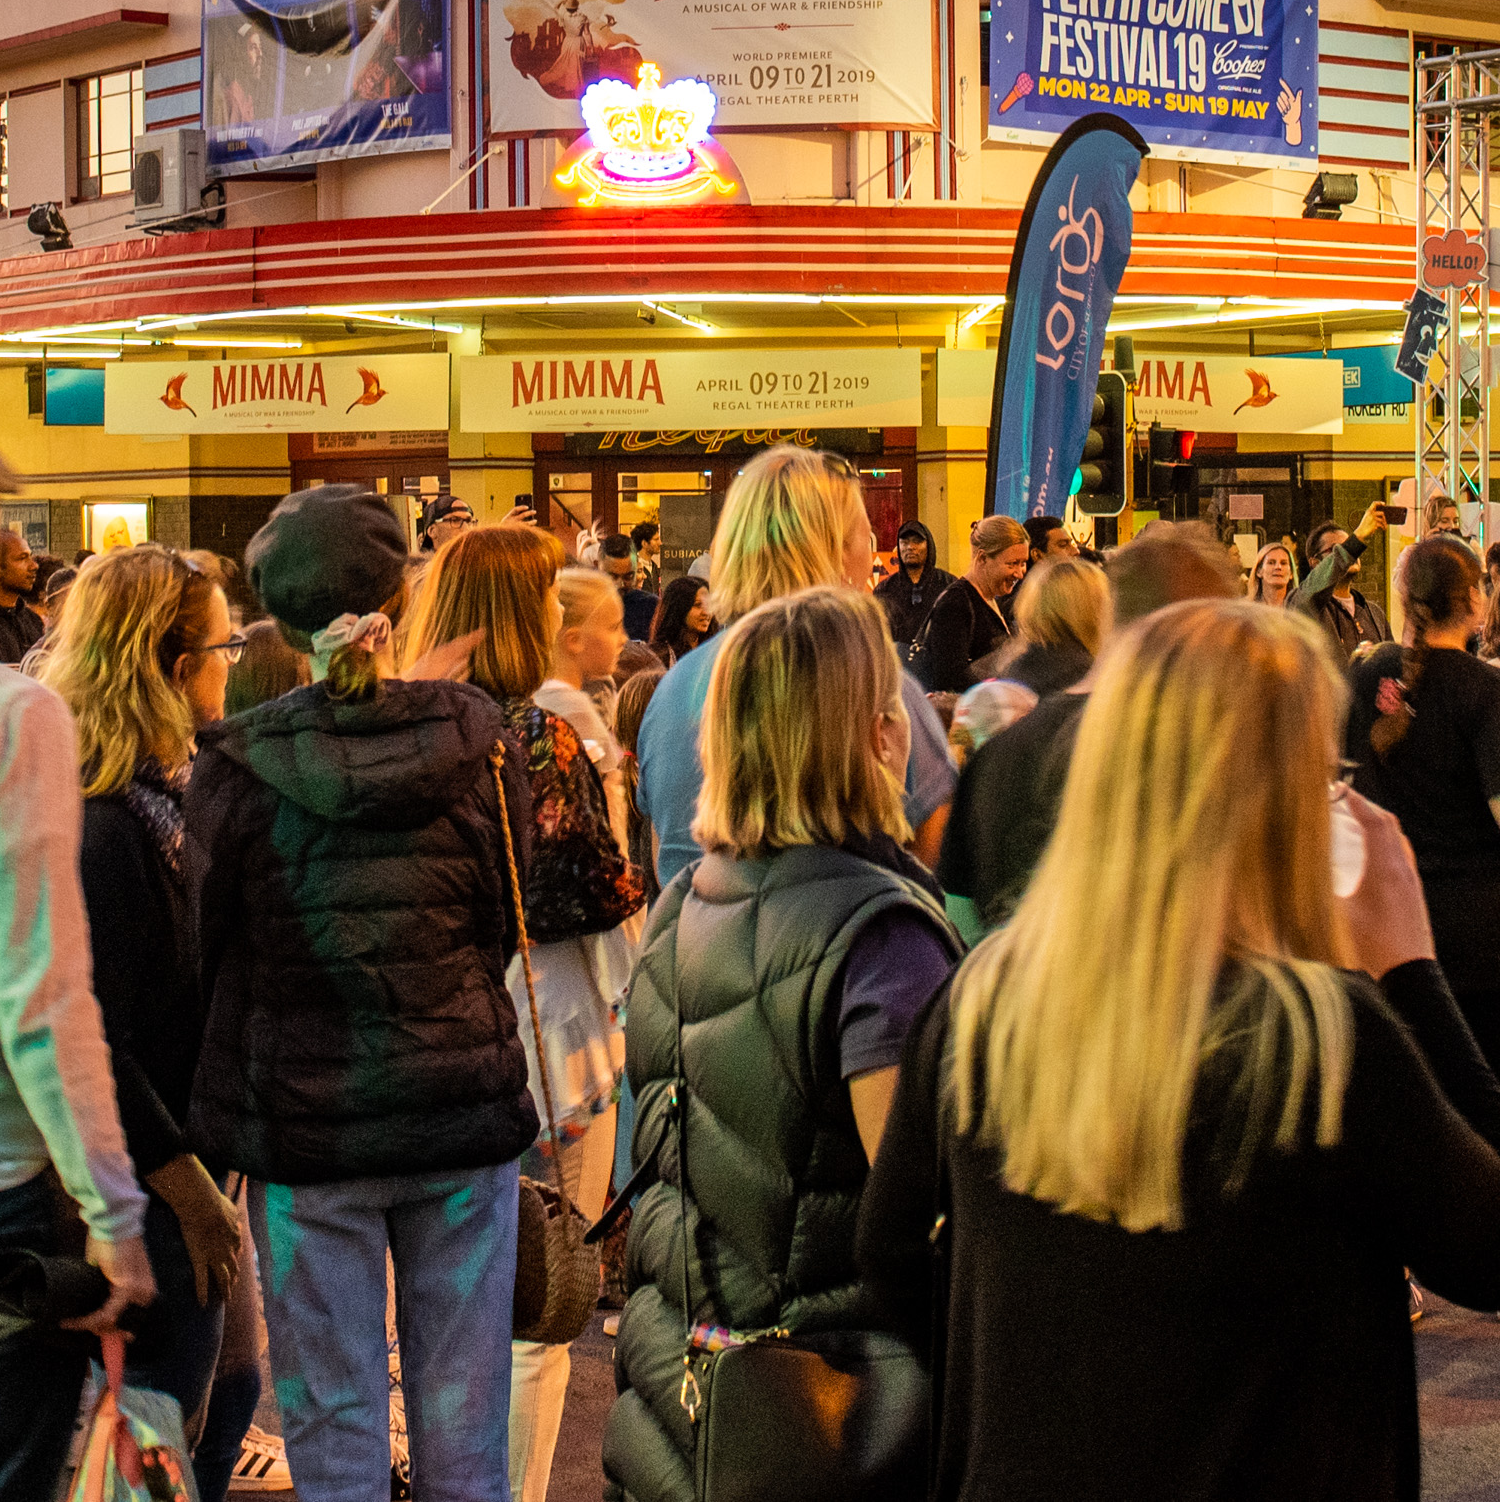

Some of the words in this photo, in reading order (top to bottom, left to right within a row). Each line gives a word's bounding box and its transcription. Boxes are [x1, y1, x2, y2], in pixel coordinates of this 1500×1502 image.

[682, 5, 690, 14] A
[693, 3, 747, 13] MUSICAL
[751, 2, 767, 12] OF
[770, 1, 797, 11] WAR
[801, 1, 809, 10] &
[813, 0, 884, 10] FRIENDSHIP
[732, 53, 773, 62] WORLD
[777, 51, 833, 60] PREMIERE
[1212, 39, 1266, 80] Coopers
[695, 73, 743, 86] APRIL
[749, 65, 780, 90] 09
[783, 67, 805, 86] TO
[810, 63, 832, 88] 21
[837, 69, 876, 83] 2019
[717, 96, 751, 107] EGAL
[756, 94, 813, 105] THEATRE
[818, 93, 859, 103] PERTH
[1038, 76, 1087, 100] MON
[1089, 82, 1108, 102] 22
[1113, 86, 1151, 108] APR
[1165, 94, 1205, 114] SUN
[1207, 97, 1228, 116] 19
[1231, 100, 1270, 120] MAY
[1432, 255, 1478, 270] HELLO!
[1067, 346, 1086, 381] CITY
[1078, 323, 1089, 346] OF
[212, 362, 328, 411] MIMMA
[511, 358, 666, 409] MIMMA
[696, 380, 743, 391] APRIL
[750, 372, 778, 395] 09
[781, 374, 803, 392] TO
[808, 371, 828, 394] 21
[833, 377, 869, 390] 2019
[1100, 360, 1213, 407] MMA
[713, 401, 751, 410] REGAL
[755, 400, 810, 410] THEATRE
[815, 400, 854, 409] PERTH
[1392, 403, 1408, 417] RD.
